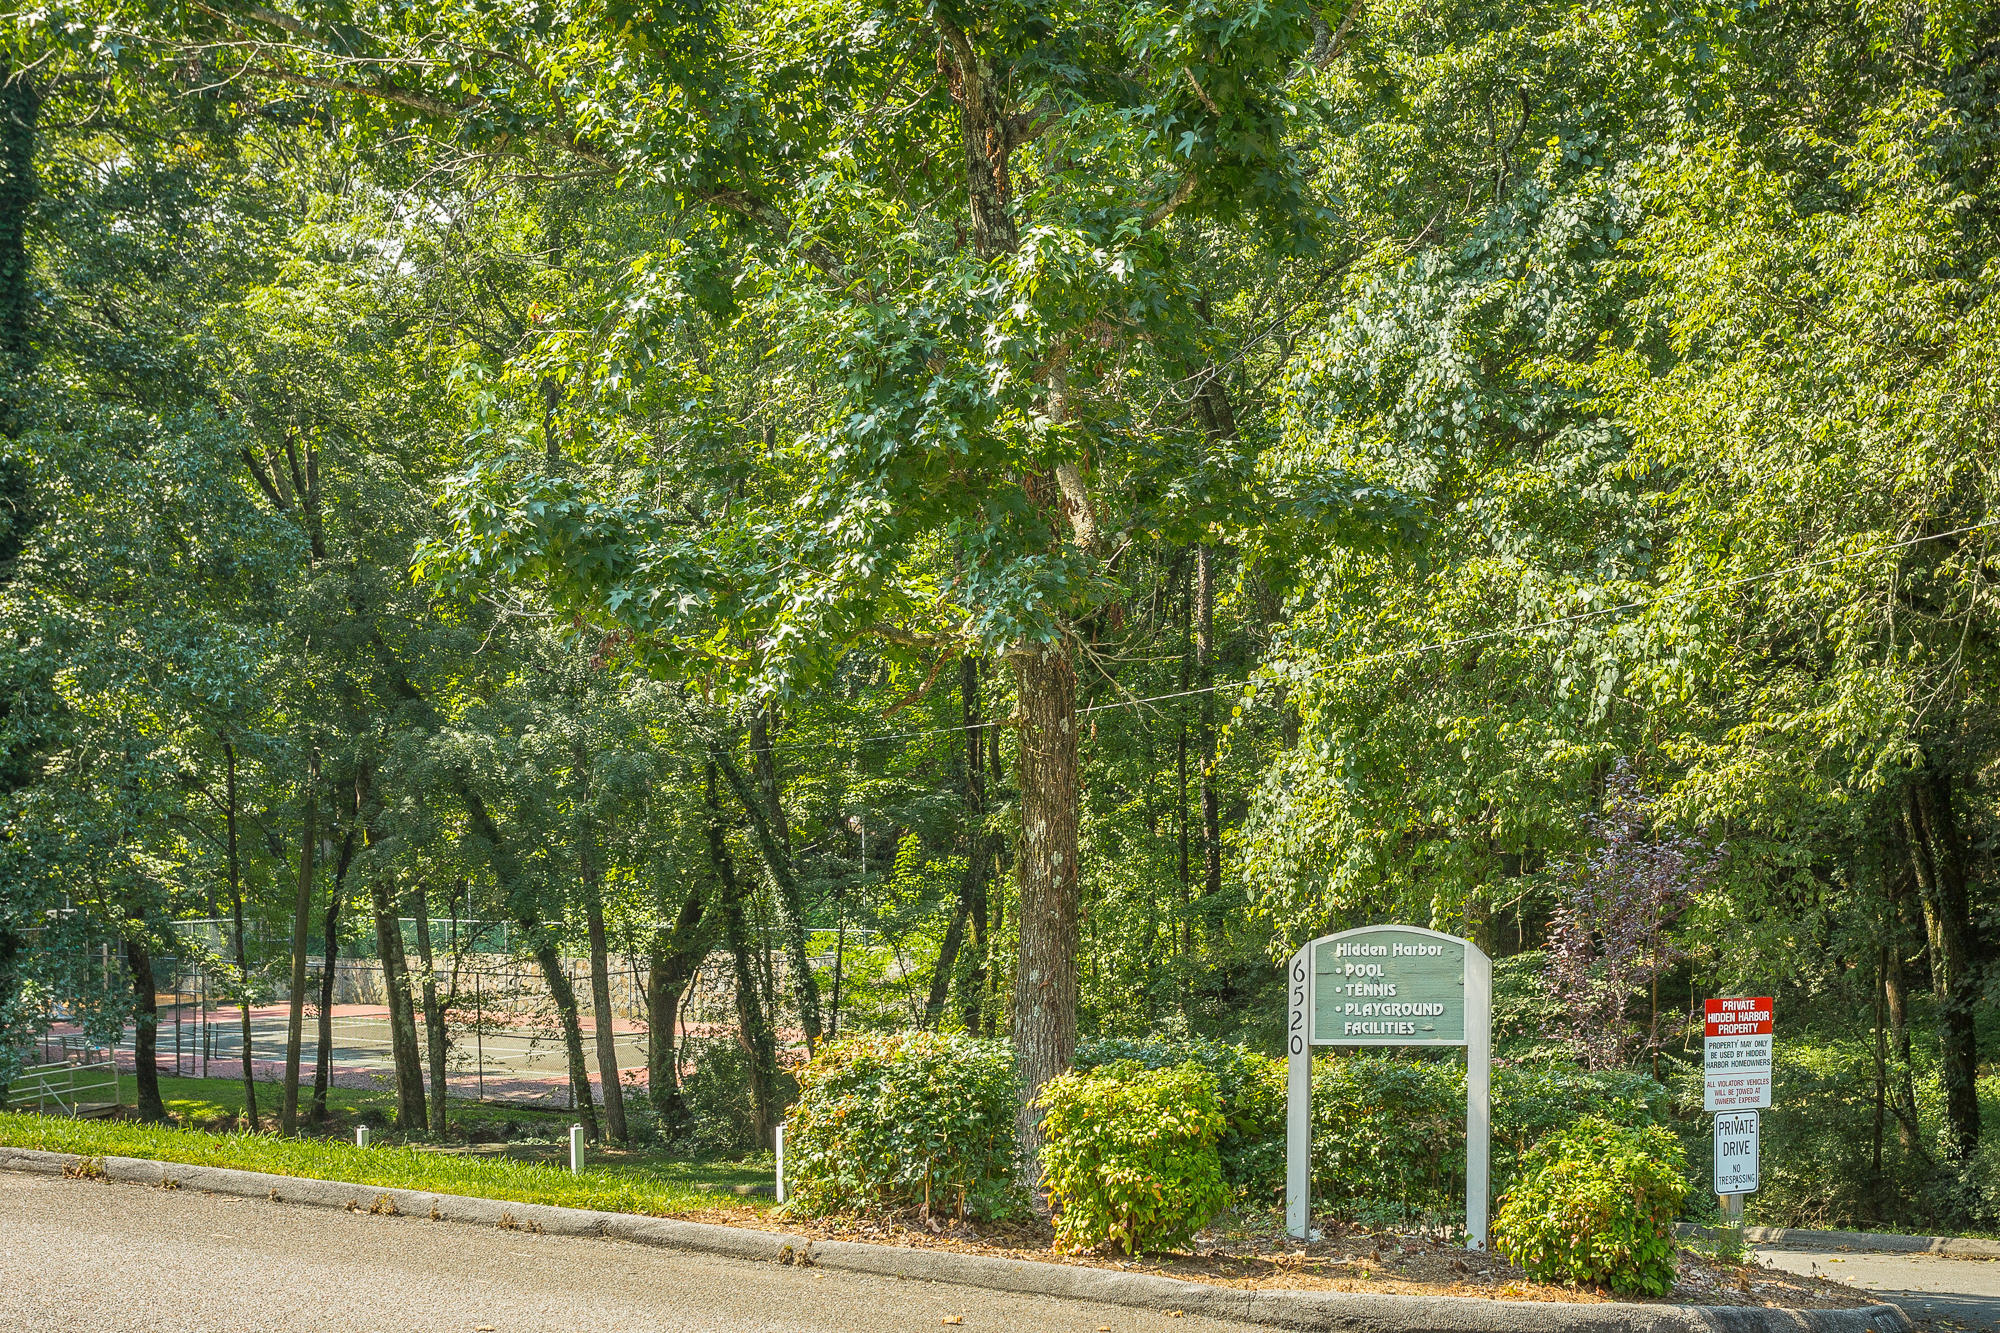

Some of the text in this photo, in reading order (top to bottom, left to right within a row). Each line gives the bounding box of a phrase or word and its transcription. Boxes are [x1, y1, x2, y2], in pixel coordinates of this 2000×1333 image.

[1336, 943, 1443, 957] Hidden Harbor
[1345, 964, 1385, 977] POOL
[1345, 983, 1397, 996] TENNIS
[1290, 959, 1305, 1055] 6520
[1344, 1002, 1444, 1016] PLAYGROUND
[1722, 1000, 1755, 1011] PRIVATE
[1708, 1011, 1769, 1023] HIDDEN HARBOR
[1344, 1022, 1415, 1035] FACILITIES
[1718, 1023, 1758, 1034] PROPERTY
[1709, 1041, 1738, 1050] PROPERTY
[1731, 1059, 1770, 1067] HOMEOWNERS
[1736, 1088, 1753, 1096] TOWED
[1719, 1120, 1754, 1136] PRIVATE
[1723, 1141, 1750, 1156] DRIVE
[1733, 1164, 1740, 1173] NO
[1719, 1174, 1754, 1185] TRESPASSING
